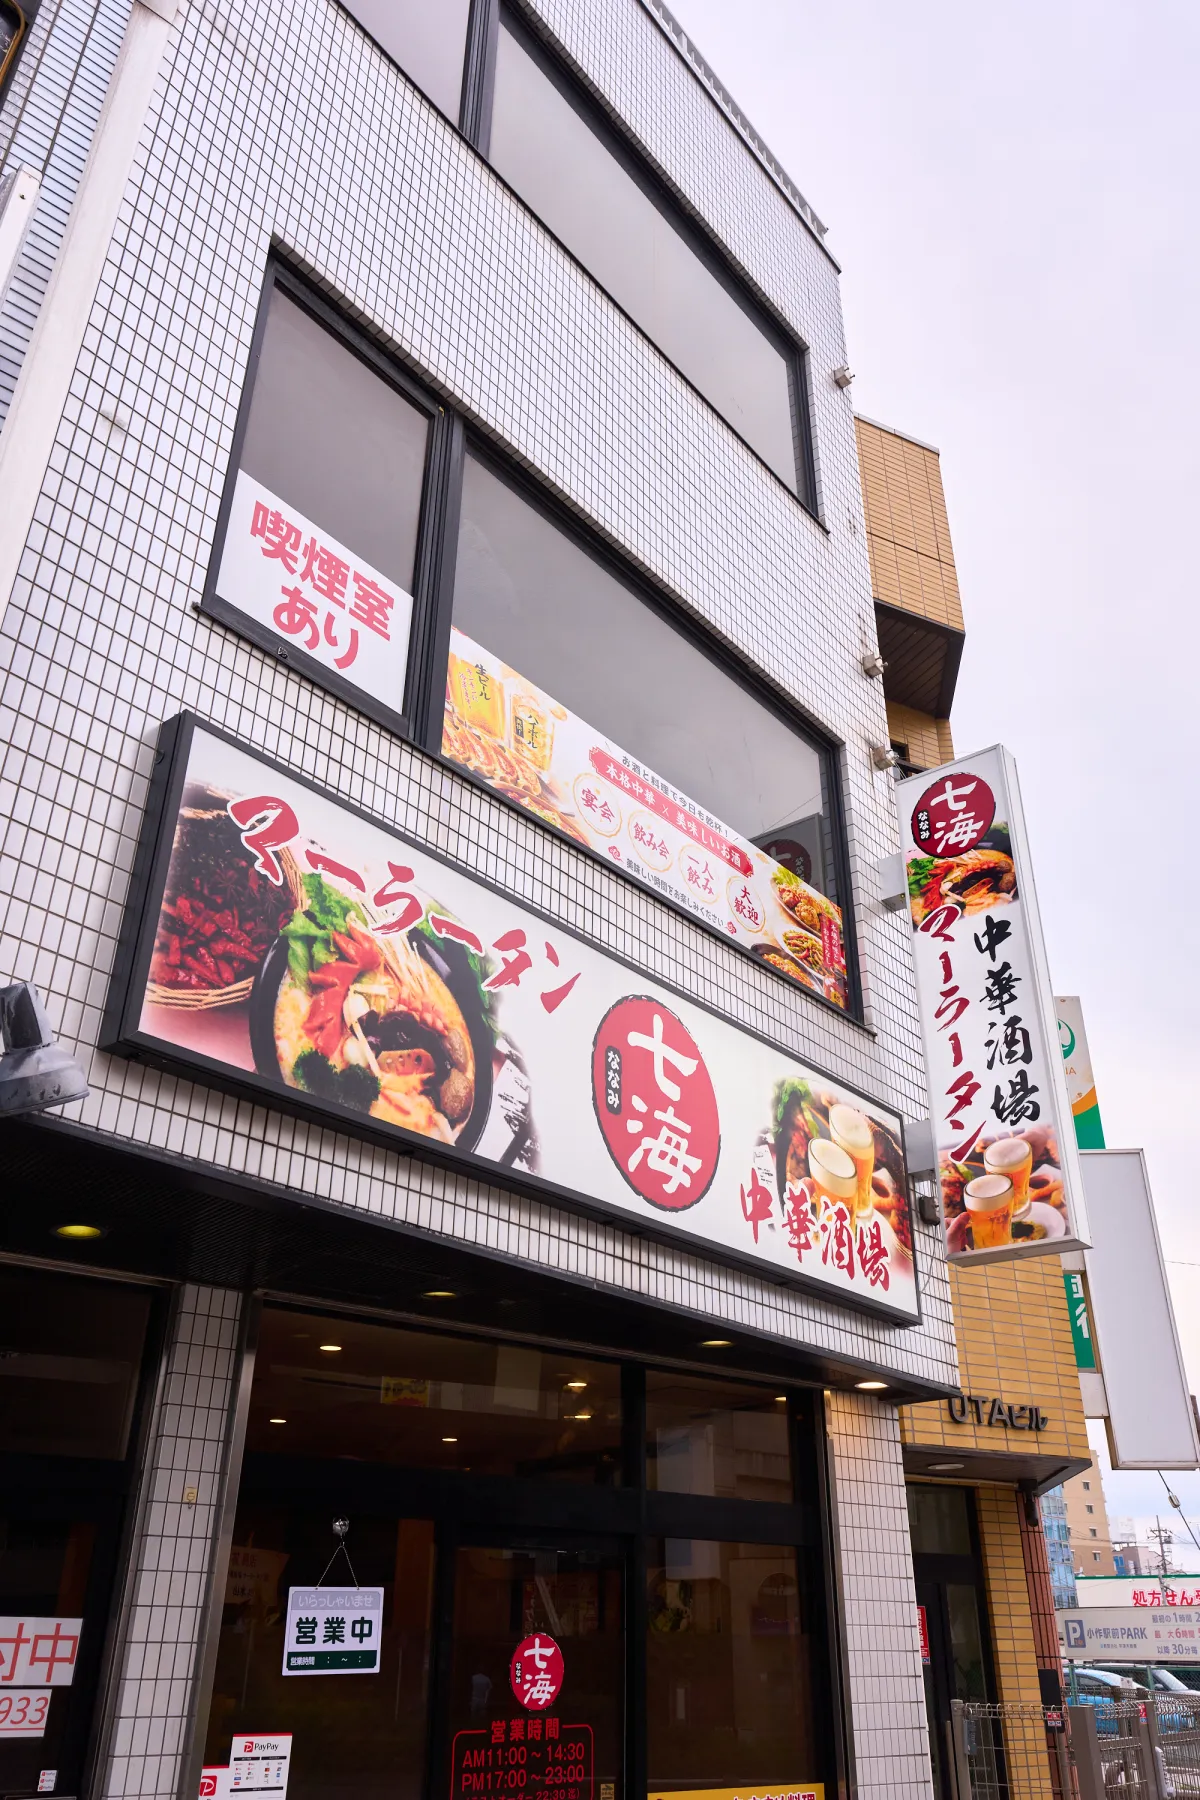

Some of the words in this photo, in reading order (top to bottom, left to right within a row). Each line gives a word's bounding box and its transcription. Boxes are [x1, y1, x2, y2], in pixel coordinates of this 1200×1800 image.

[250, 500, 395, 642] 喫煙室
[272, 585, 360, 670] あり
[475, 663, 491, 701] 生ビール
[527, 714, 539, 749] ハイボール
[580, 786, 616, 823] 宴会
[606, 762, 656, 804] 本格中華
[675, 811, 741, 868] 美味しいお酒
[930, 780, 984, 854] 七海
[633, 821, 671, 861] 飲み会
[917, 810, 931, 840] ななみ
[686, 866, 715, 896] 飲み
[687, 854, 715, 881] 一人
[228, 796, 582, 1014] マーラータン
[626, 857, 724, 927] 美味しい時間をお楽しみください
[740, 885, 753, 905] 大
[918, 904, 987, 1162] マーラータン
[973, 914, 1041, 1127] 中華酒場
[606, 1050, 621, 1108] ななみ
[626, 1013, 703, 1194] 七海
[740, 1166, 890, 1292] 中華酒場
[948, 1395, 1049, 1431] UTAビル
[298, 1595, 375, 1608] いらっしゃいませ
[295, 1616, 374, 1645] 営業中
[290, 1656, 316, 1666] 営業時間
[523, 1637, 557, 1705] 七海
[254, 1742, 279, 1752] PayPay
[490, 1717, 560, 1744] 営業時間
[546, 1742, 585, 1762] 14:30
[545, 1764, 585, 1785] 23:00
